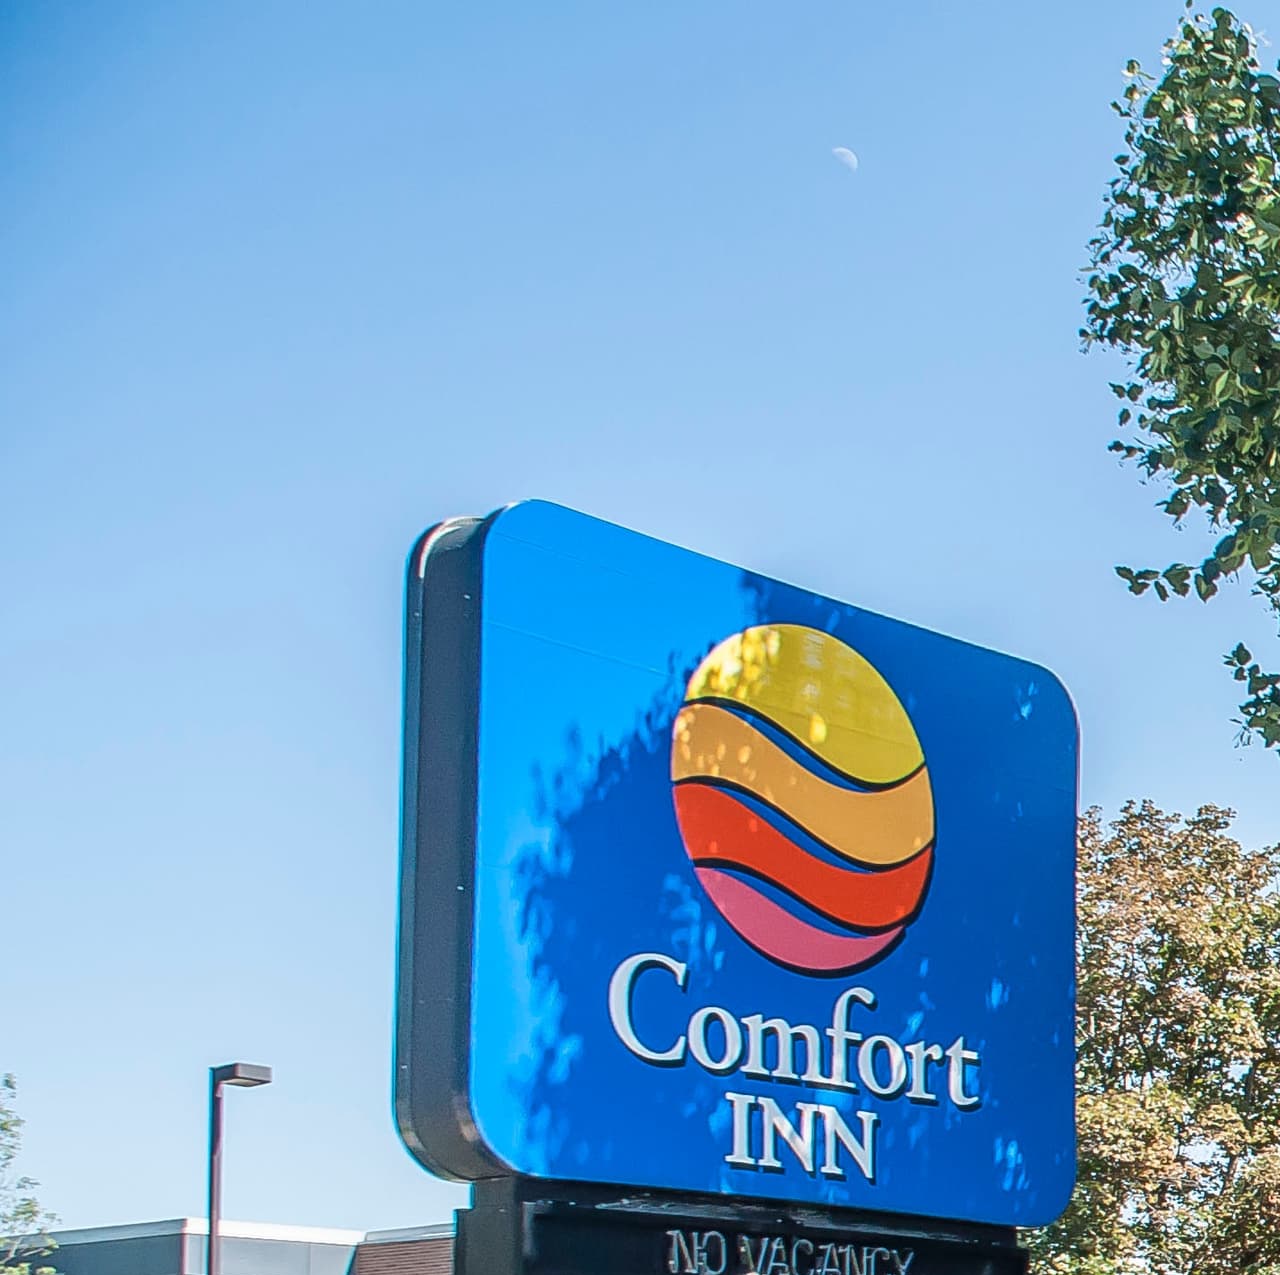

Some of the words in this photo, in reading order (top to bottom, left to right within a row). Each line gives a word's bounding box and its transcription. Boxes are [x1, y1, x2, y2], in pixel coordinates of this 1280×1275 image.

[609, 952, 980, 1106] Comfort
[725, 1091, 877, 1179] INN
[668, 1230, 728, 1275] NO
